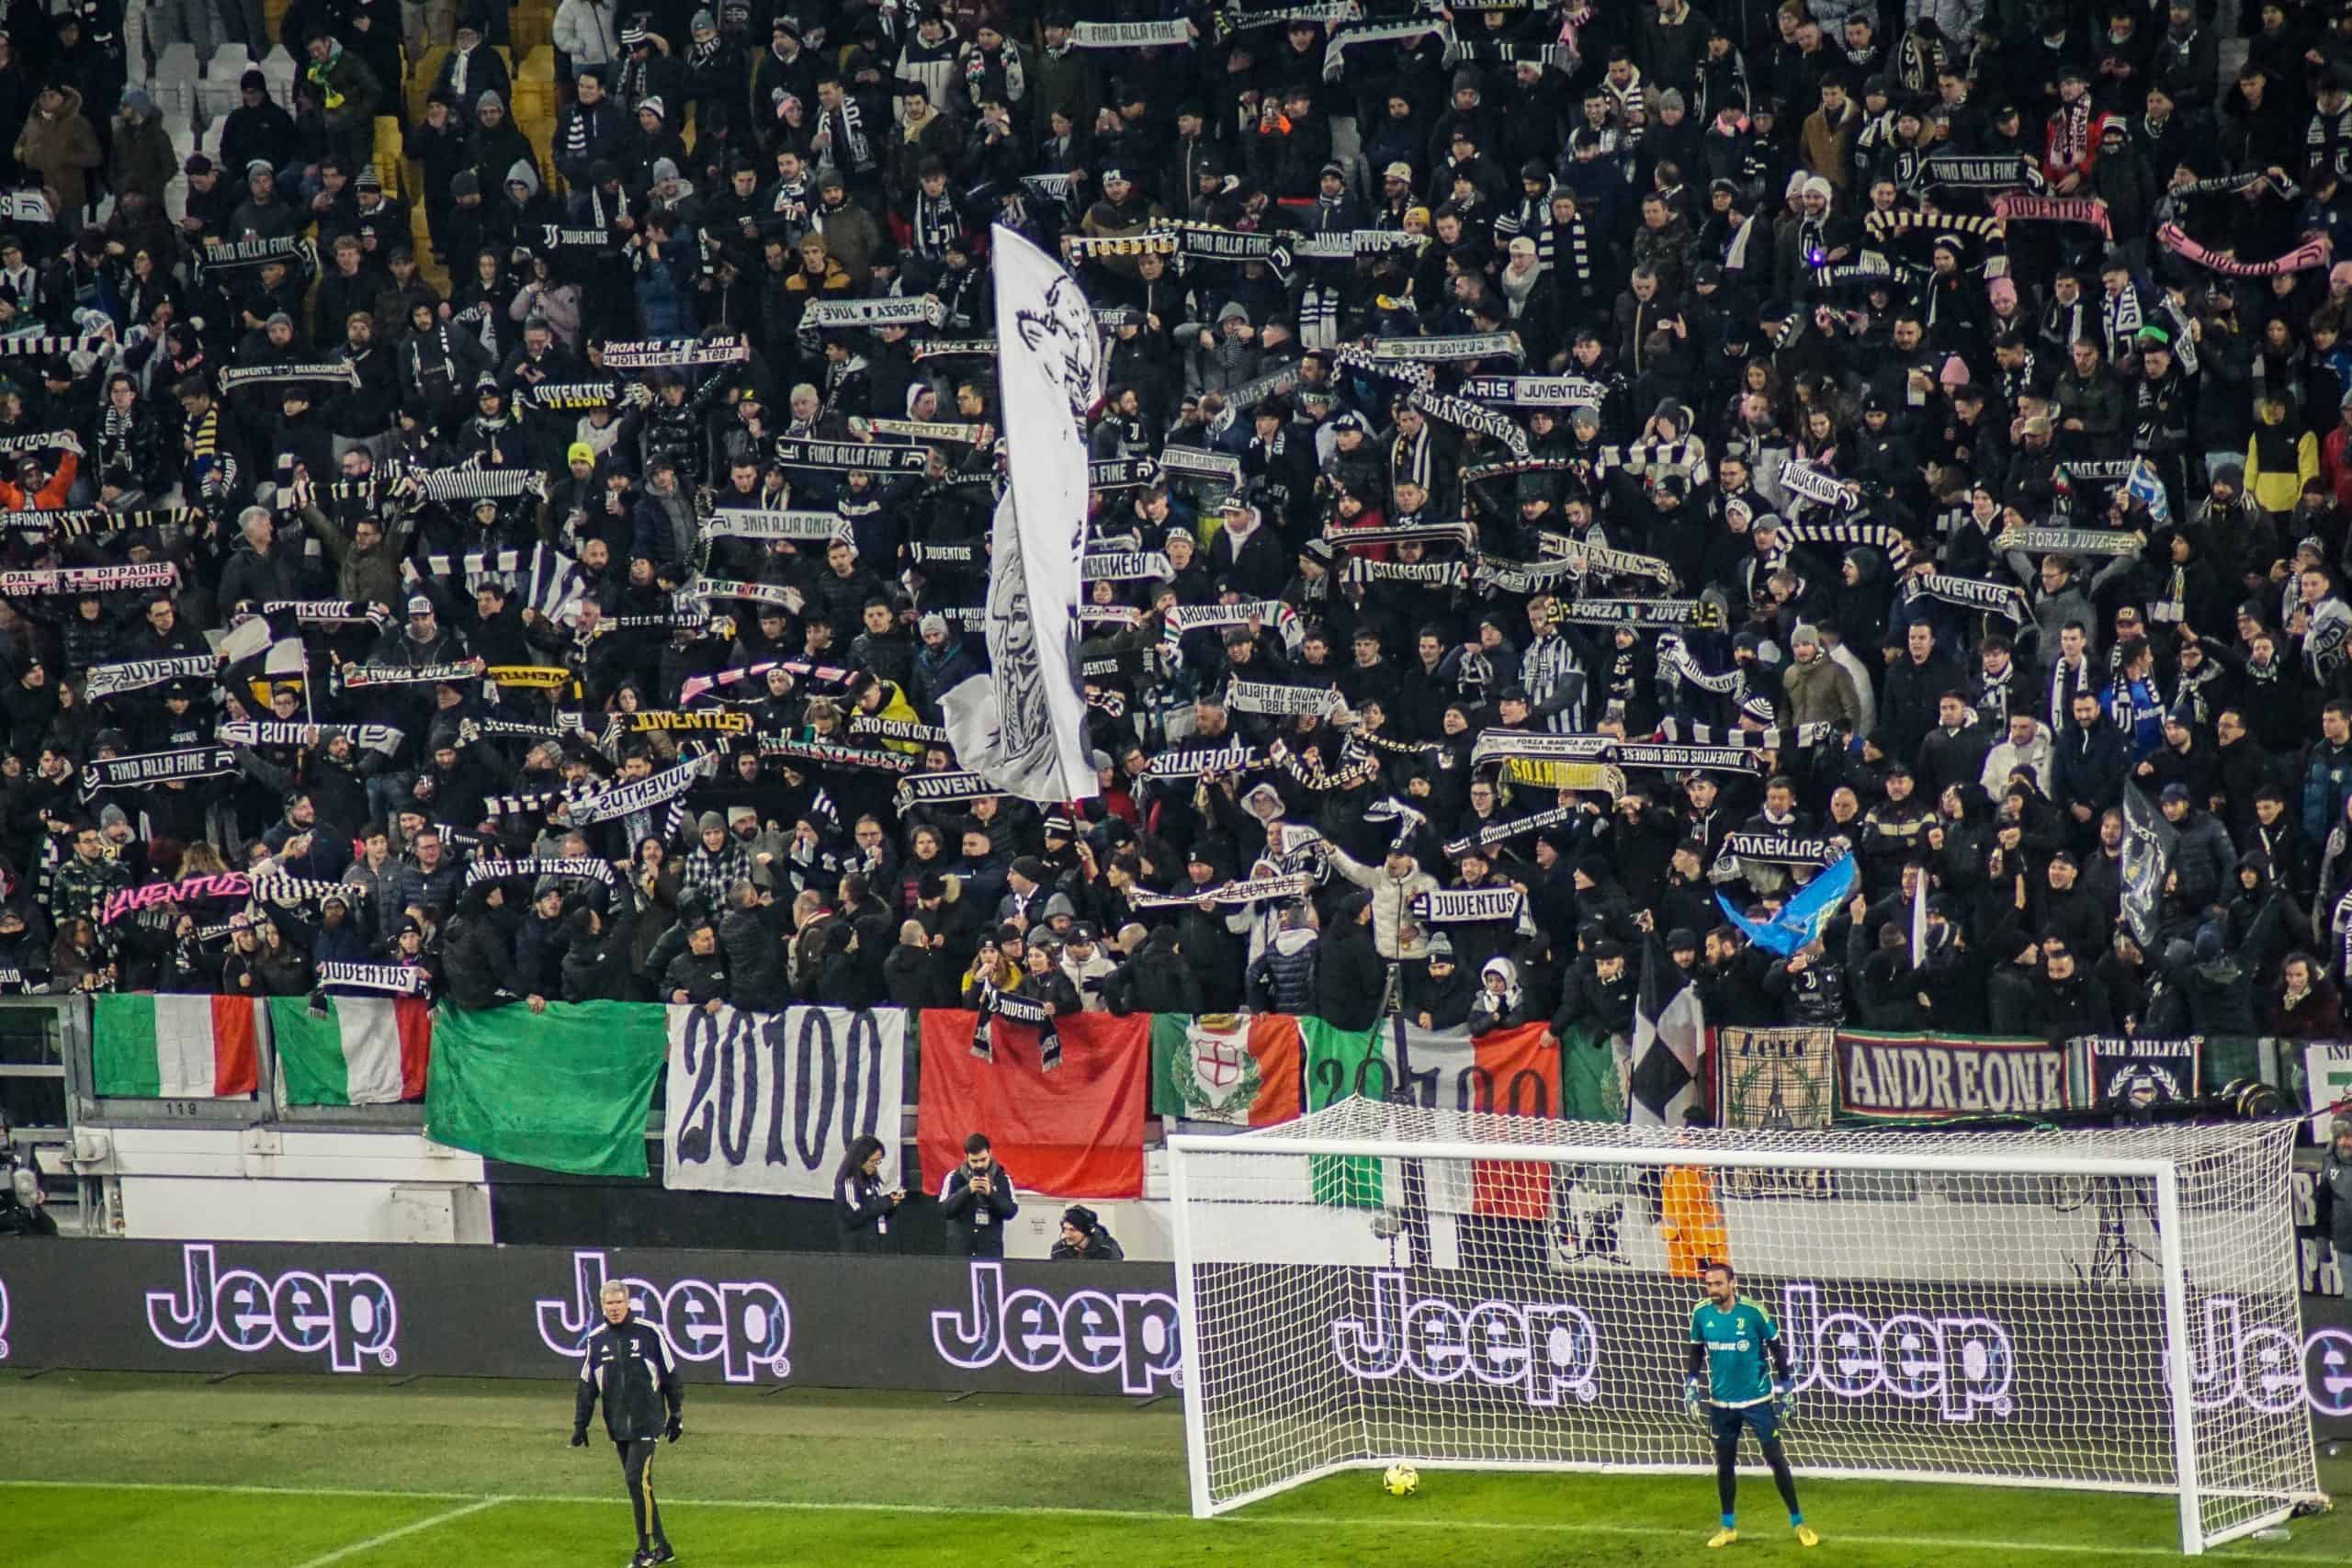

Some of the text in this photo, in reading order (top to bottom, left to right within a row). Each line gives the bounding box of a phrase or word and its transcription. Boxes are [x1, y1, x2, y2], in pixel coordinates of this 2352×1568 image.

[1091, 24, 1176, 42] FINO ALLA FINE
[1931, 163, 2018, 180] FINO ALLA FINE
[2006, 197, 2094, 220] JUVENTUS
[560, 229, 608, 245] JUVENTUS
[1186, 232, 1272, 255] FINO ALLA FINE
[1315, 231, 1392, 254] JUVENTUS
[208, 241, 236, 262] FINO
[237, 238, 266, 259] ALLA
[1523, 383, 1593, 400] JUVENTUS
[808, 444, 893, 468] FINO ALLA FINE
[1101, 464, 1128, 482] FINE
[1787, 466, 1837, 502] JUVENTUS
[2027, 531, 2069, 547] FORZA
[924, 545, 972, 561] JUVENTUS
[1553, 541, 1645, 571] JUVENTUS
[3, 575, 172, 596] 1897 IN FIGLIO
[6, 565, 169, 586] DAL DI PADRE
[1924, 576, 2008, 604] JUVENTUS
[1571, 603, 1690, 623] FORZA JUVE
[119, 655, 222, 682] JUVENTUS
[631, 712, 745, 732] JUVENTUS
[1150, 746, 1258, 777] JUVENTUS
[1662, 749, 1689, 763] CLUB
[1690, 750, 1745, 766] JUVENTUS
[109, 753, 207, 784] FINO ALLA FINE
[917, 776, 990, 797] JUVENT
[465, 859, 616, 888] AMICI DI NESSUNO
[1435, 892, 1516, 917] JUVENTUS
[322, 961, 410, 988] JUVENTUS
[1000, 998, 1046, 1022] JUVENTUS
[2093, 1038, 2192, 1057] CHI MILITA
[1850, 1044, 2063, 1111] ANDREONE
[677, 1007, 883, 1172] 20100
[164, 1101, 198, 1117] 119
[146, 1244, 398, 1372] Jeep
[932, 1261, 1183, 1395] Jeep
[1333, 1272, 1597, 1406] Jeep
